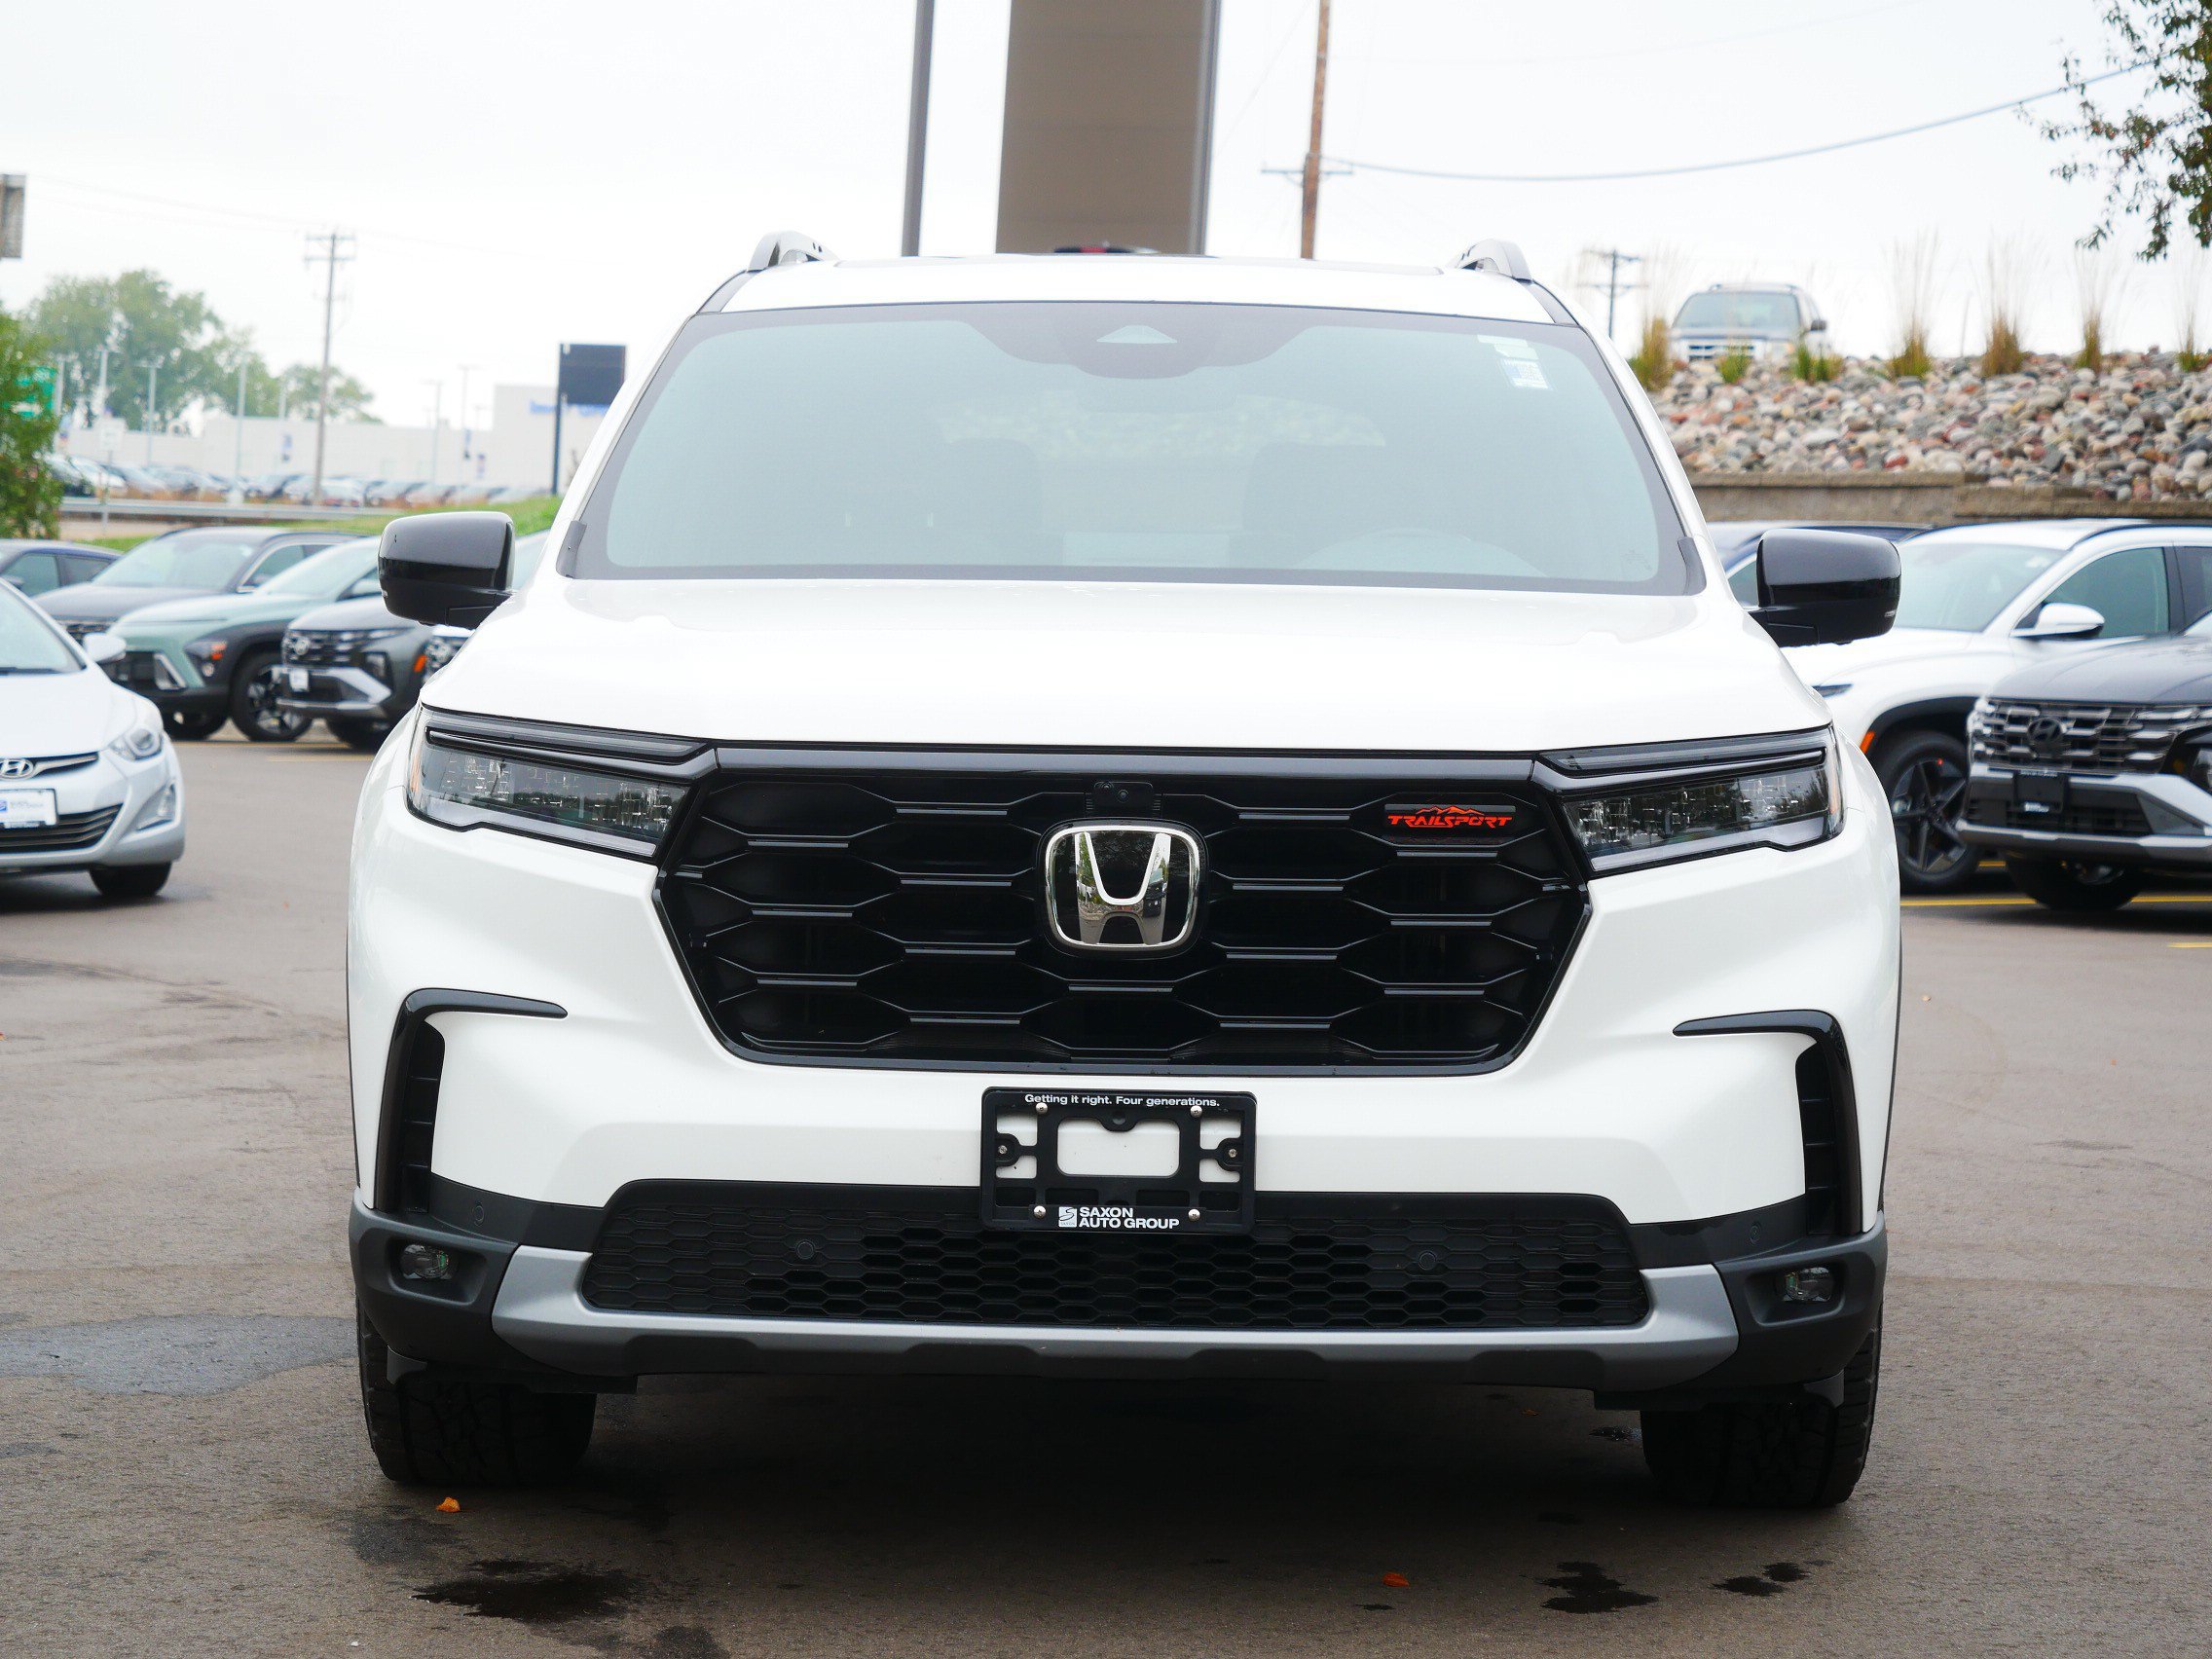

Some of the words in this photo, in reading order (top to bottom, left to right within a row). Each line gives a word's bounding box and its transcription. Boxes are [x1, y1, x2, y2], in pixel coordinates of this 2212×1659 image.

[1387, 815, 1512, 829] TRAILSPORT
[1024, 1093, 1068, 1105] Getting
[1070, 1094, 1079, 1104] it
[1082, 1095, 1112, 1106] right.
[1116, 1095, 1143, 1105] Four
[1146, 1096, 1220, 1107] generations.
[1079, 1206, 1133, 1218] SAXON
[1079, 1217, 1121, 1228] AUTO
[1124, 1218, 1180, 1229] GROUP
